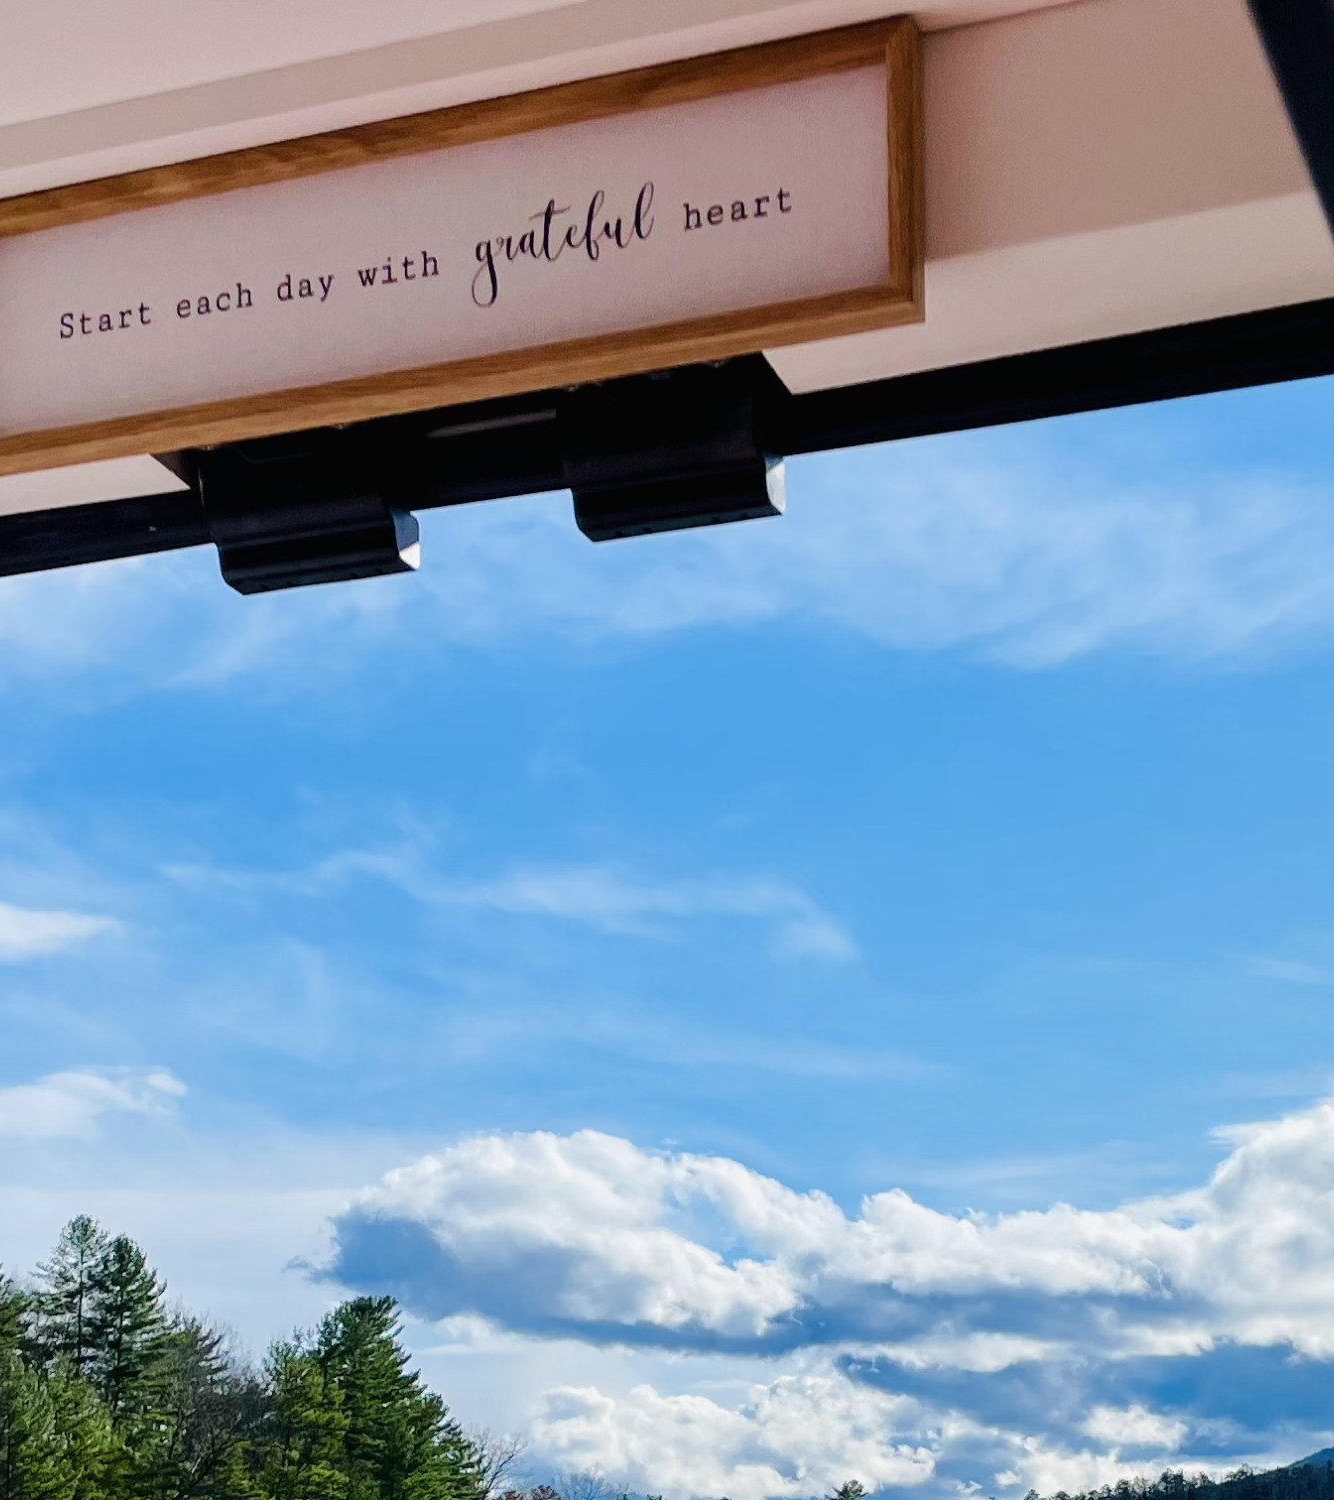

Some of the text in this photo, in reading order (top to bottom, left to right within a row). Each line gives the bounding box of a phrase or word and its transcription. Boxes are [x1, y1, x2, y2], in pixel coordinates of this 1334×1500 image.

[58, 181, 793, 340] Start each day with grateful heart
